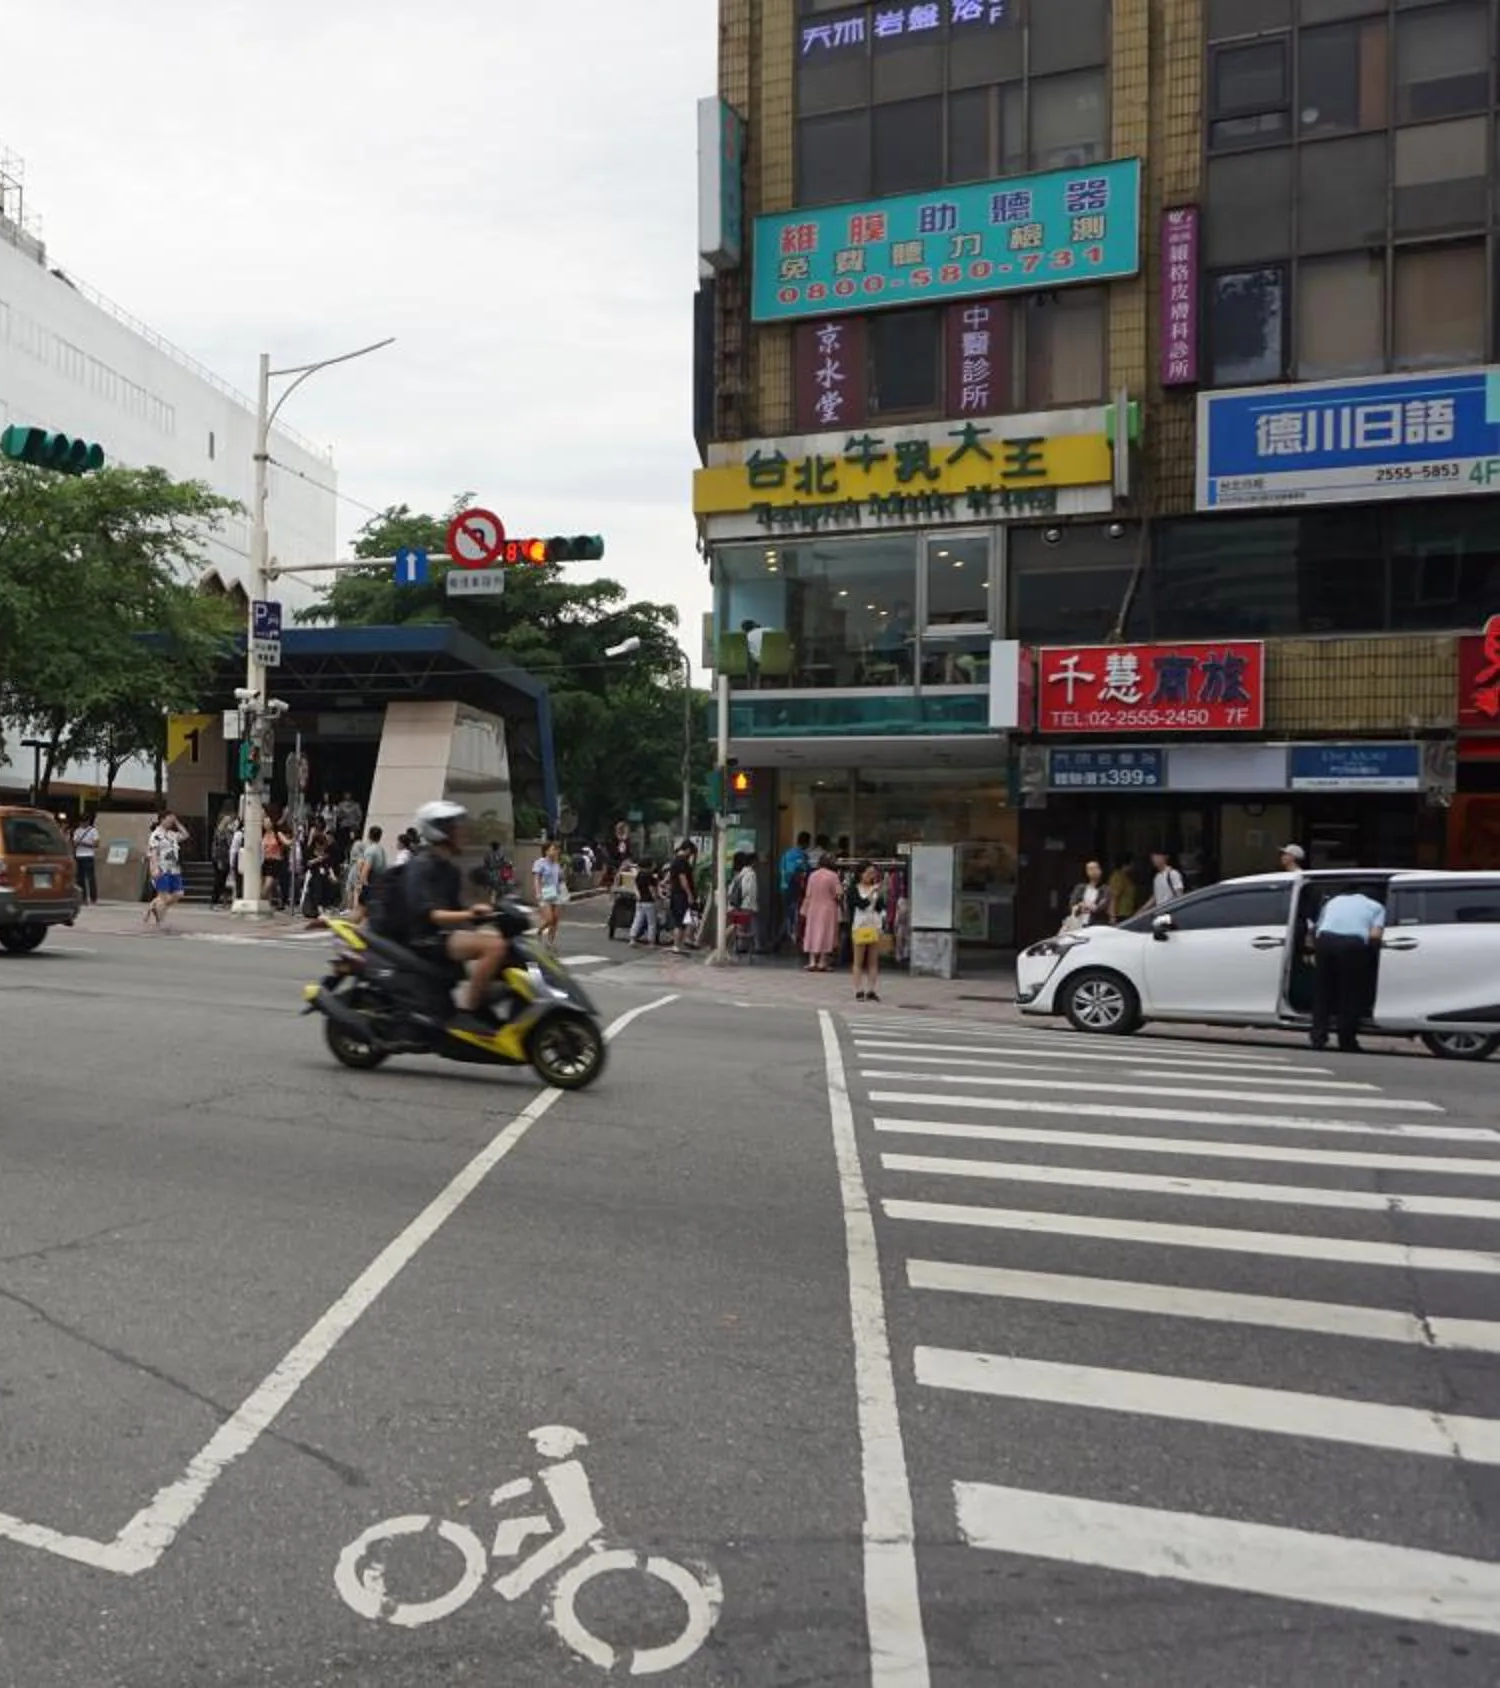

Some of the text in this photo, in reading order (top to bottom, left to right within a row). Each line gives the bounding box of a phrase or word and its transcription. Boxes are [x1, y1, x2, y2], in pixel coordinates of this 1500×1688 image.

[777, 246, 1105, 304] 0800-580-731
[814, 322, 846, 425] 京水堂
[1255, 397, 1455, 457] 德川日語
[746, 421, 1047, 495] 台北牛乳大王
[1375, 464, 1460, 481] 2555-5853
[1225, 707, 1249, 724] 7F
[184, 727, 199, 763] 1
